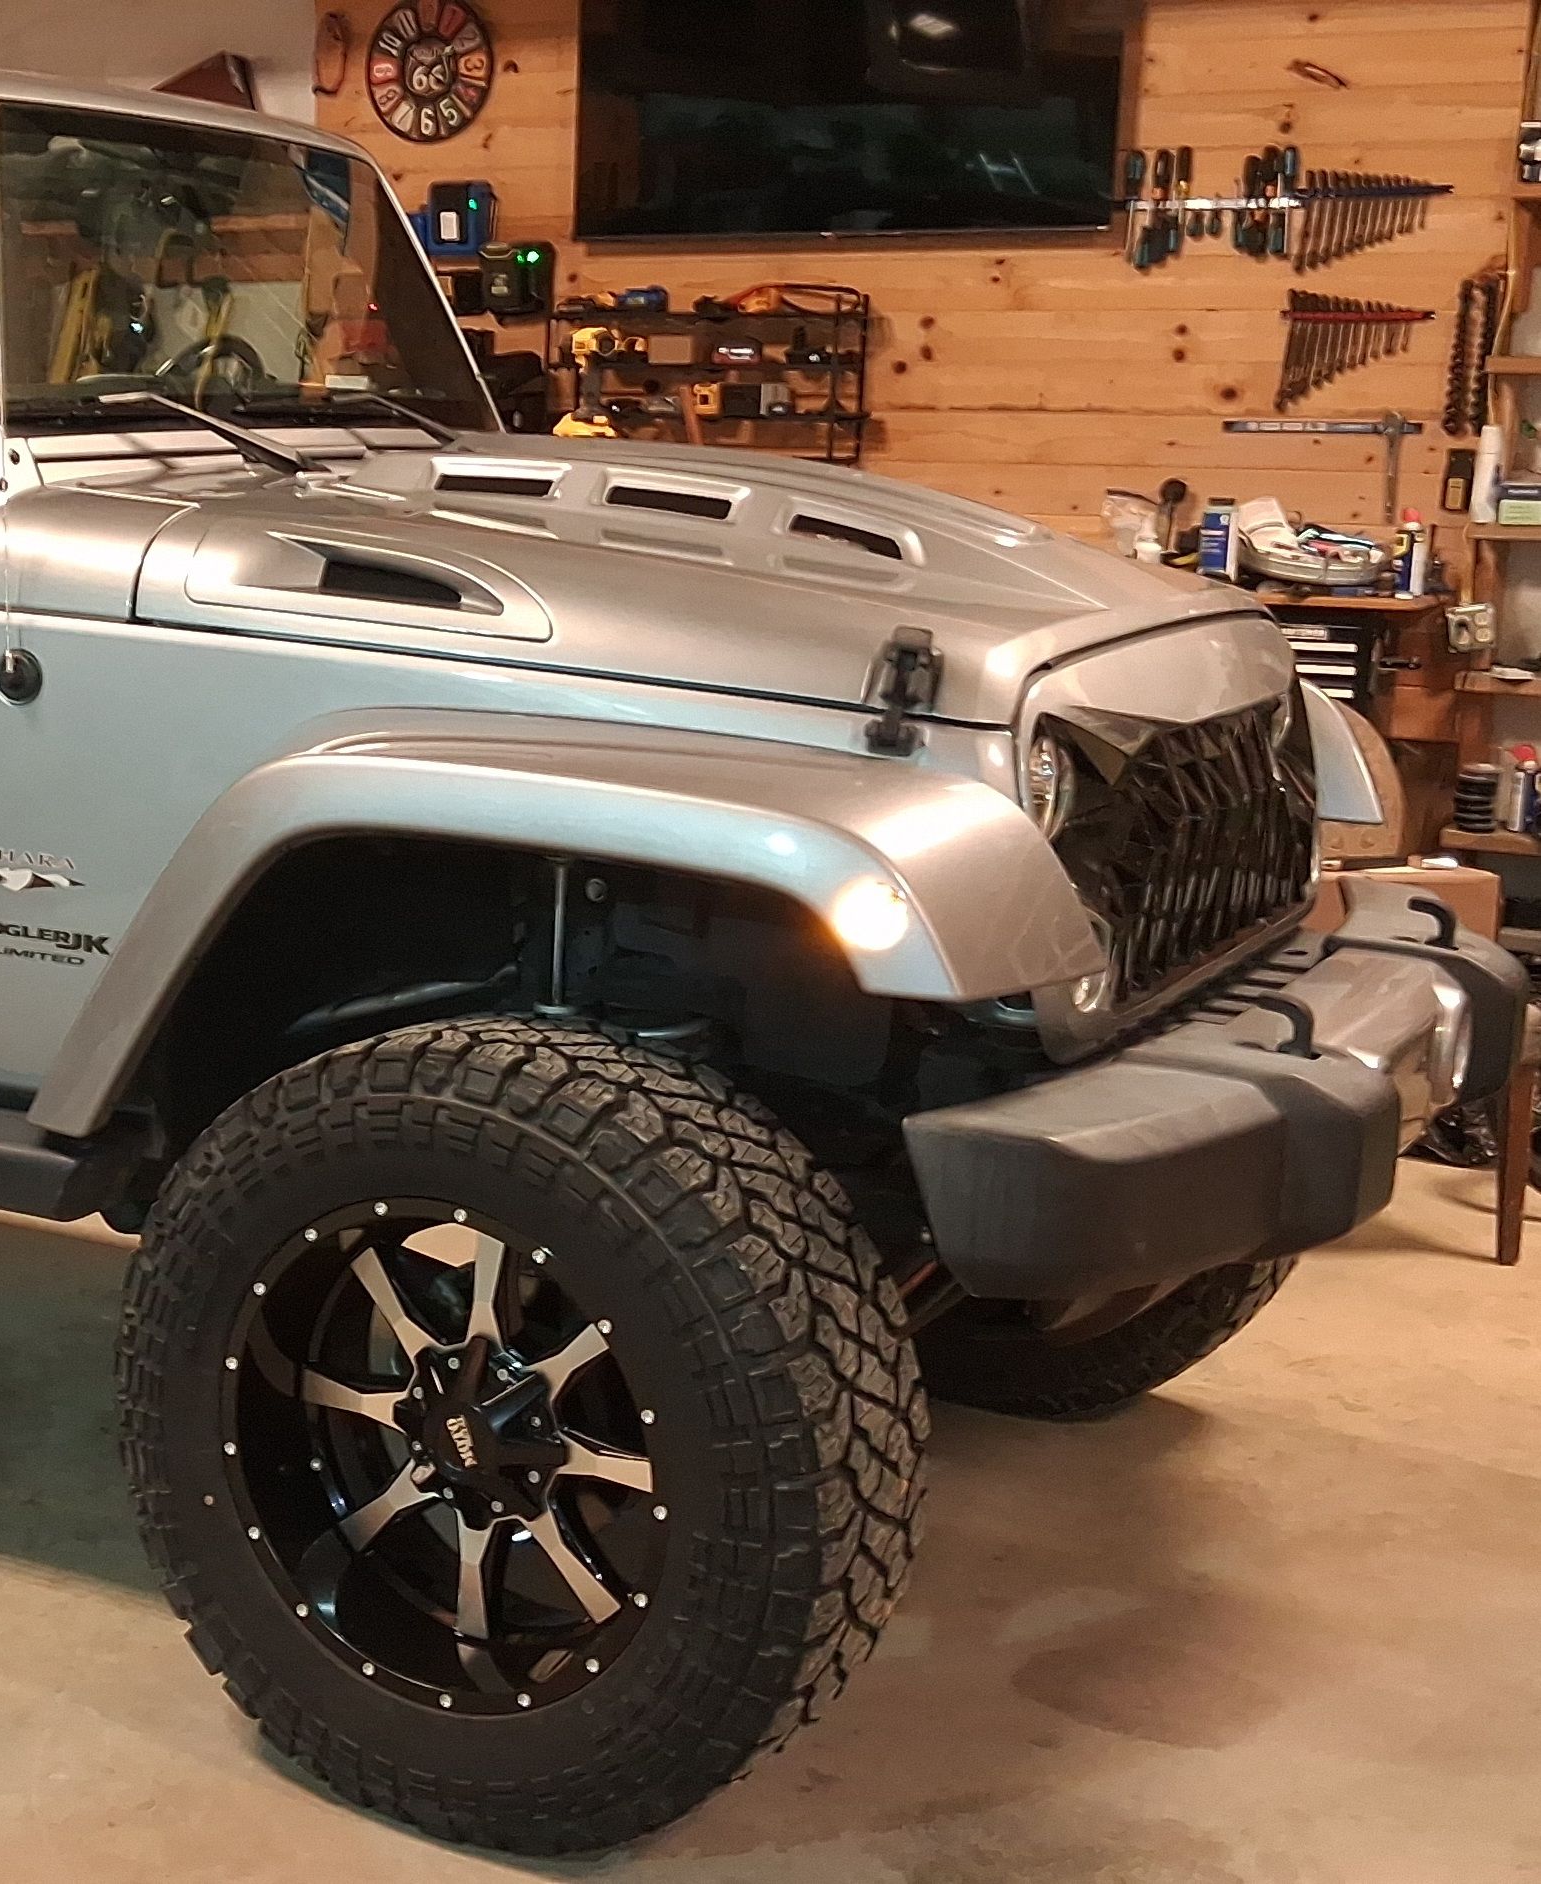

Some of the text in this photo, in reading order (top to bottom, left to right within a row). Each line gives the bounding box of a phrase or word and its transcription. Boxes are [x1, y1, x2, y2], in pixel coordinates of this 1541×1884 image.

[378, 33, 402, 57] 10
[463, 57, 485, 72] 3
[420, 107, 435, 136] 6
[439, 97, 458, 127] 5
